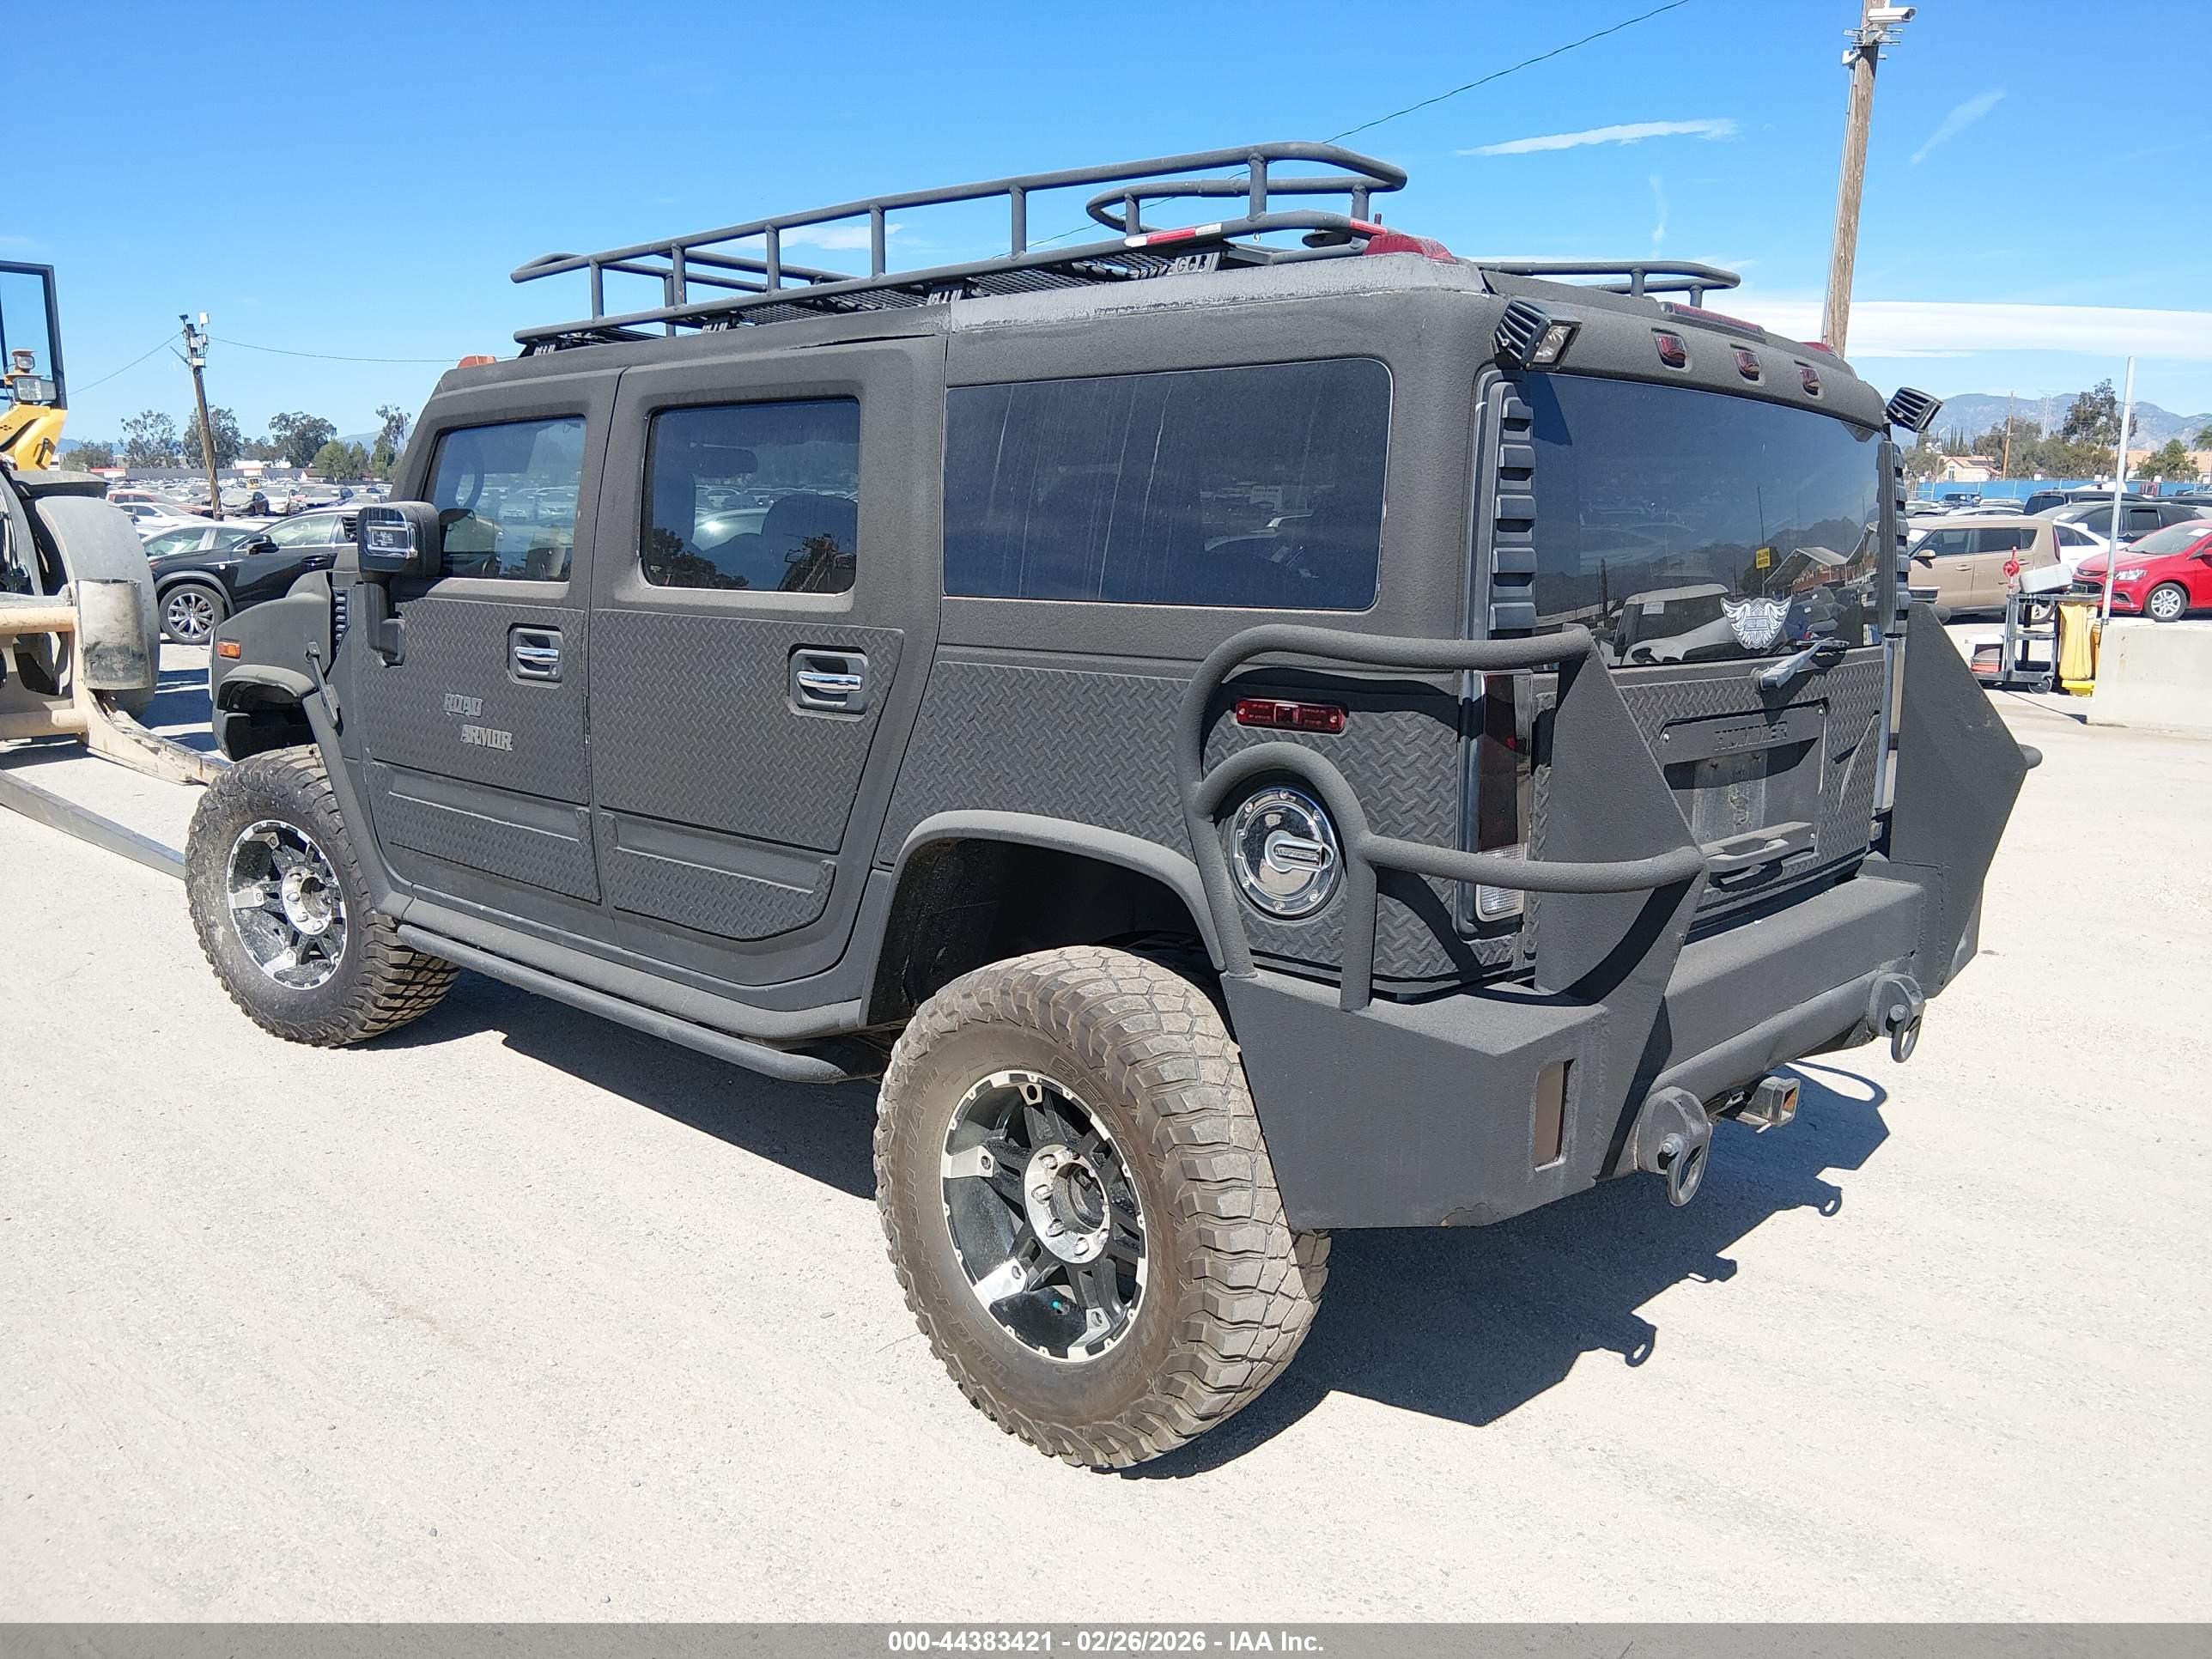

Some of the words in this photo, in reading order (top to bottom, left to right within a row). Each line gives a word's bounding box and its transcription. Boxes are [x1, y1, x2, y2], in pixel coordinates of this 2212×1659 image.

[1176, 252, 1215, 272] GOBI
[443, 692, 483, 718] ROAD
[460, 724, 514, 751] ARMOR
